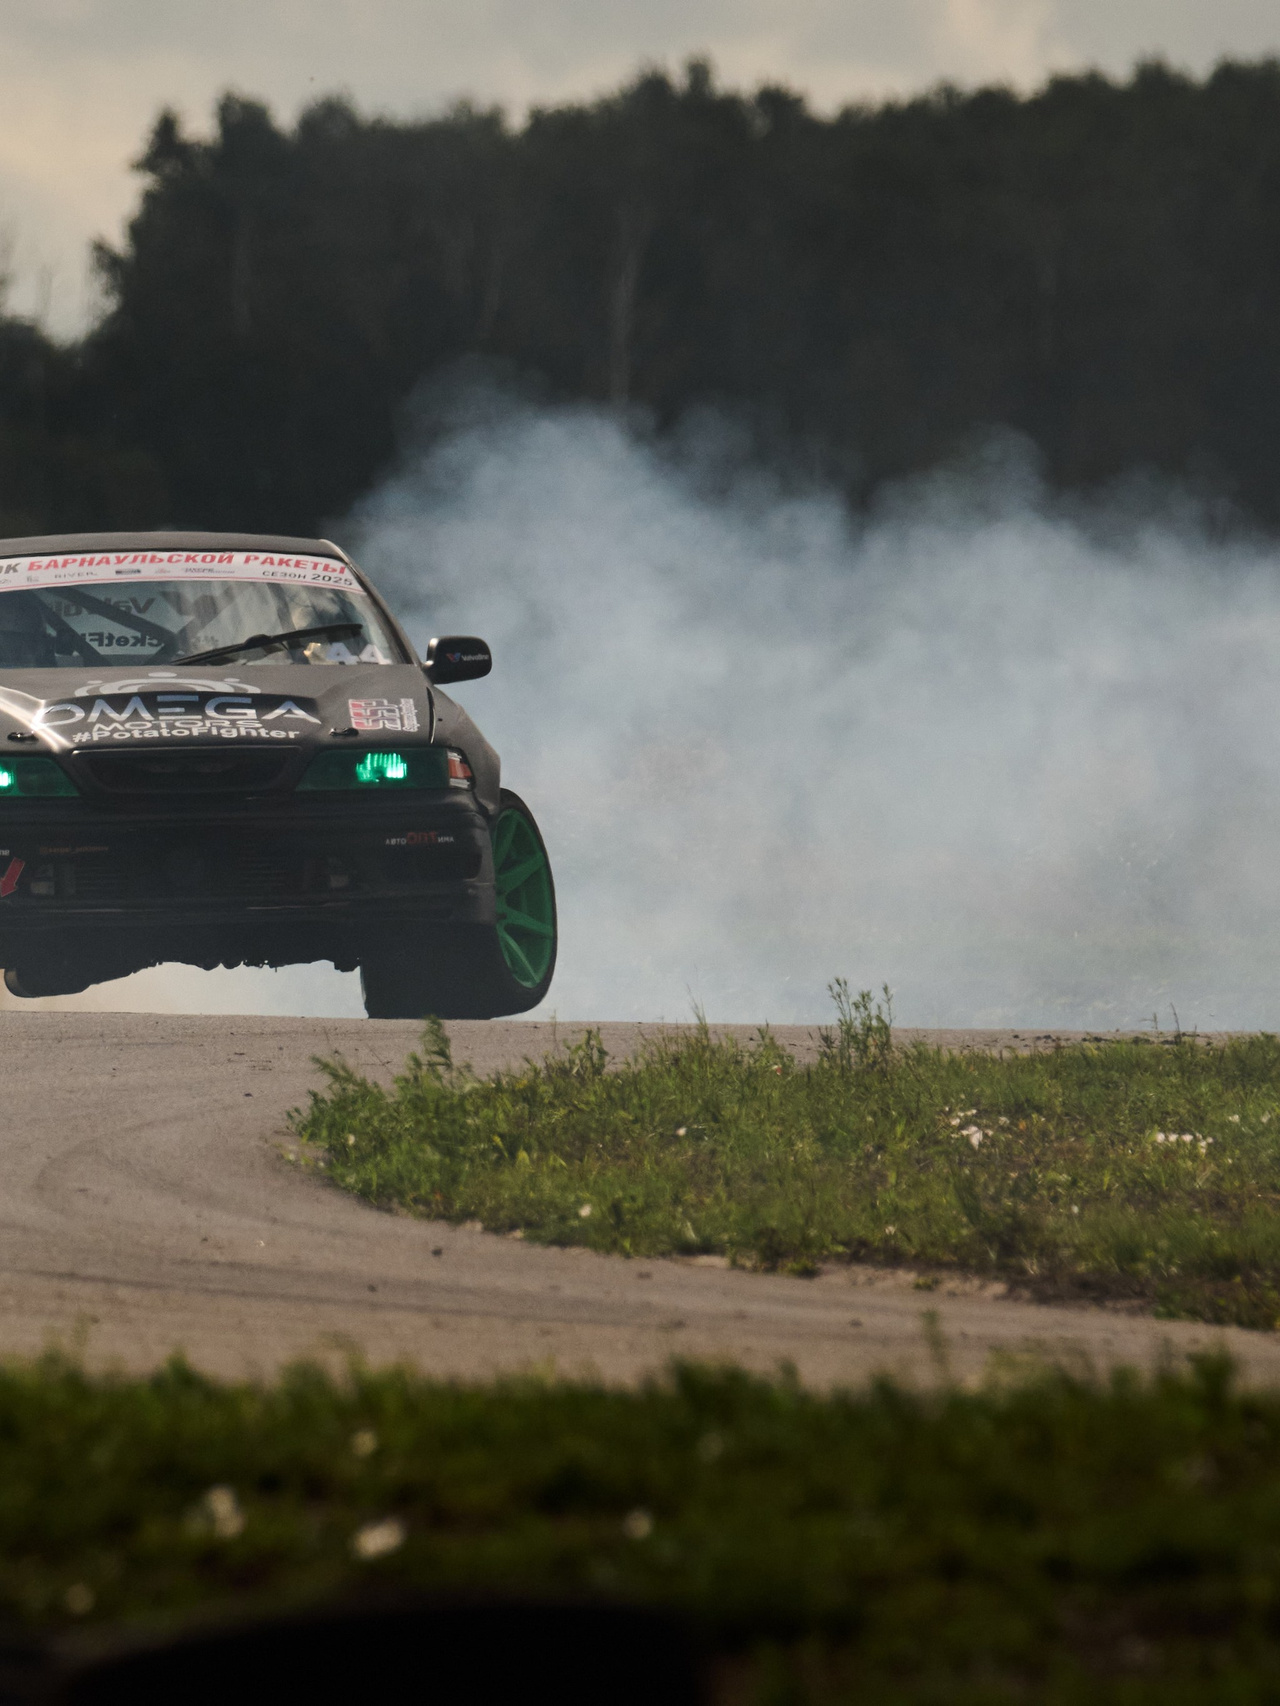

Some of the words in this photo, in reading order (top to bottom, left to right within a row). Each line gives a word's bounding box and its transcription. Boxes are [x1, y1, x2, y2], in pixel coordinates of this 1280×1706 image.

[28, 552, 234, 571] БАРНАУЛЬСКОЙ
[243, 554, 346, 574] РАКЕТЫ
[262, 570, 307, 580] СЕЗОН
[311, 573, 353, 586] 2025
[32, 694, 322, 727] OMEGA
[72, 726, 300, 743] #PotatoFighter
[92, 720, 264, 732] MOTORS
